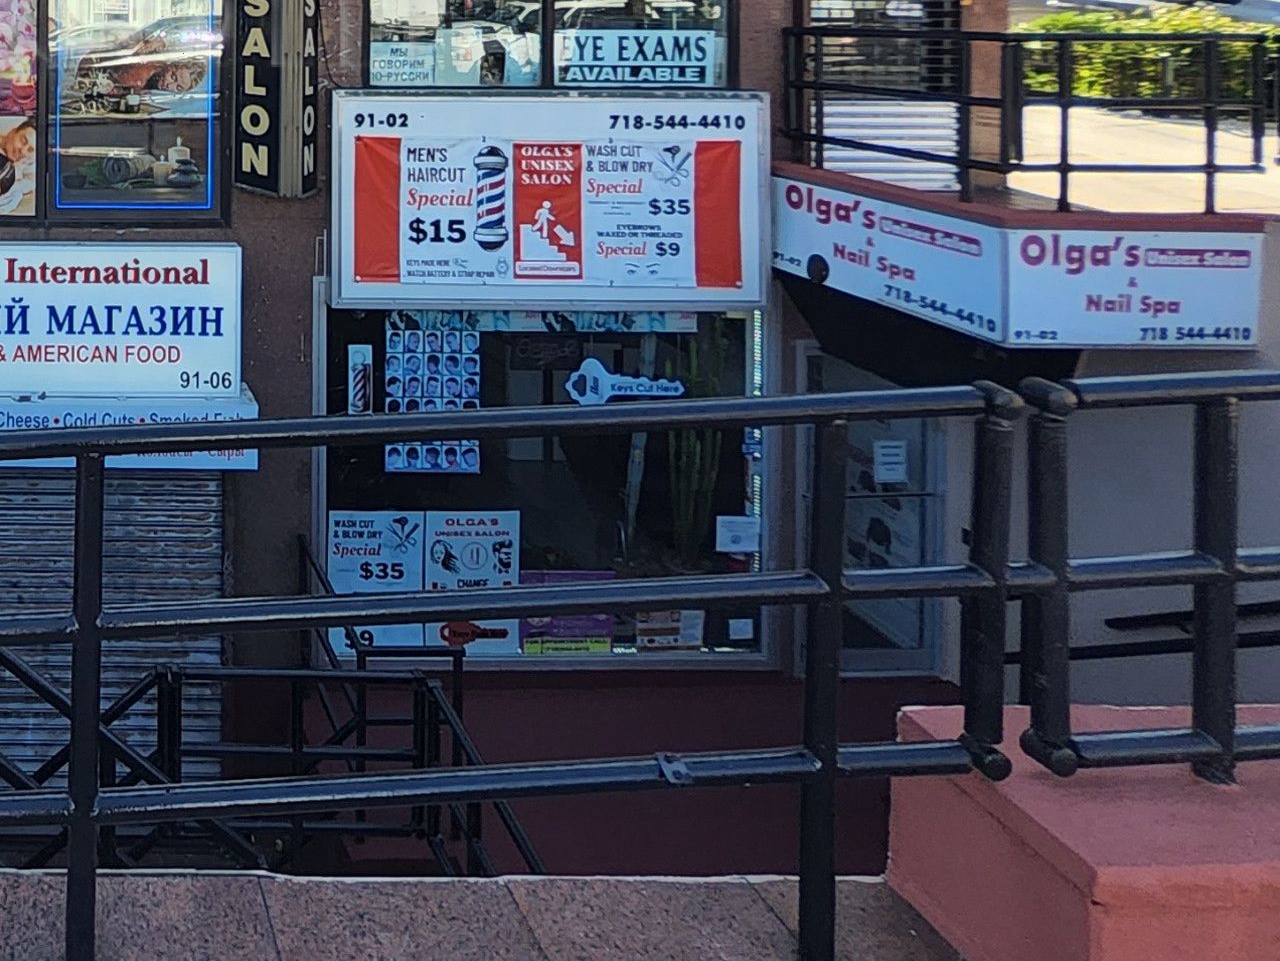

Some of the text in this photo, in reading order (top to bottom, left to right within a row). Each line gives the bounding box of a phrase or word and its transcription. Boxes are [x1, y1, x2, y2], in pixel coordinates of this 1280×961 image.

[617, 36, 708, 63] EXAMS
[565, 66, 700, 84] AVAILABLE
[354, 113, 409, 129] 91-02
[609, 114, 746, 131] 718-544-4410
[406, 147, 448, 163] MEN'S
[521, 146, 573, 157] OLGA'S
[585, 145, 642, 157] WASH CUT
[521, 160, 575, 171] UNISEX
[586, 160, 654, 173] & BLOW DRY
[407, 167, 466, 184] HAIRCUT
[521, 173, 572, 185] SALON
[586, 178, 644, 197] Special
[406, 188, 474, 210] Special
[648, 197, 691, 216] $35
[785, 184, 877, 230] Olga's
[408, 217, 467, 245] $15
[596, 241, 681, 259] Special $9
[1020, 234, 1141, 275] Olga's
[4, 257, 210, 285] International
[833, 242, 917, 282] Nail Spa
[1085, 294, 1181, 318] Nail Spa
[46, 305, 224, 337] МАГАЗИН
[12, 346, 118, 364] AMERICAN
[125, 345, 181, 364] FOOD
[180, 370, 233, 391] 91-06
[333, 519, 375, 528] WASH CUT
[333, 542, 383, 559] Special
[359, 561, 405, 581] $35
